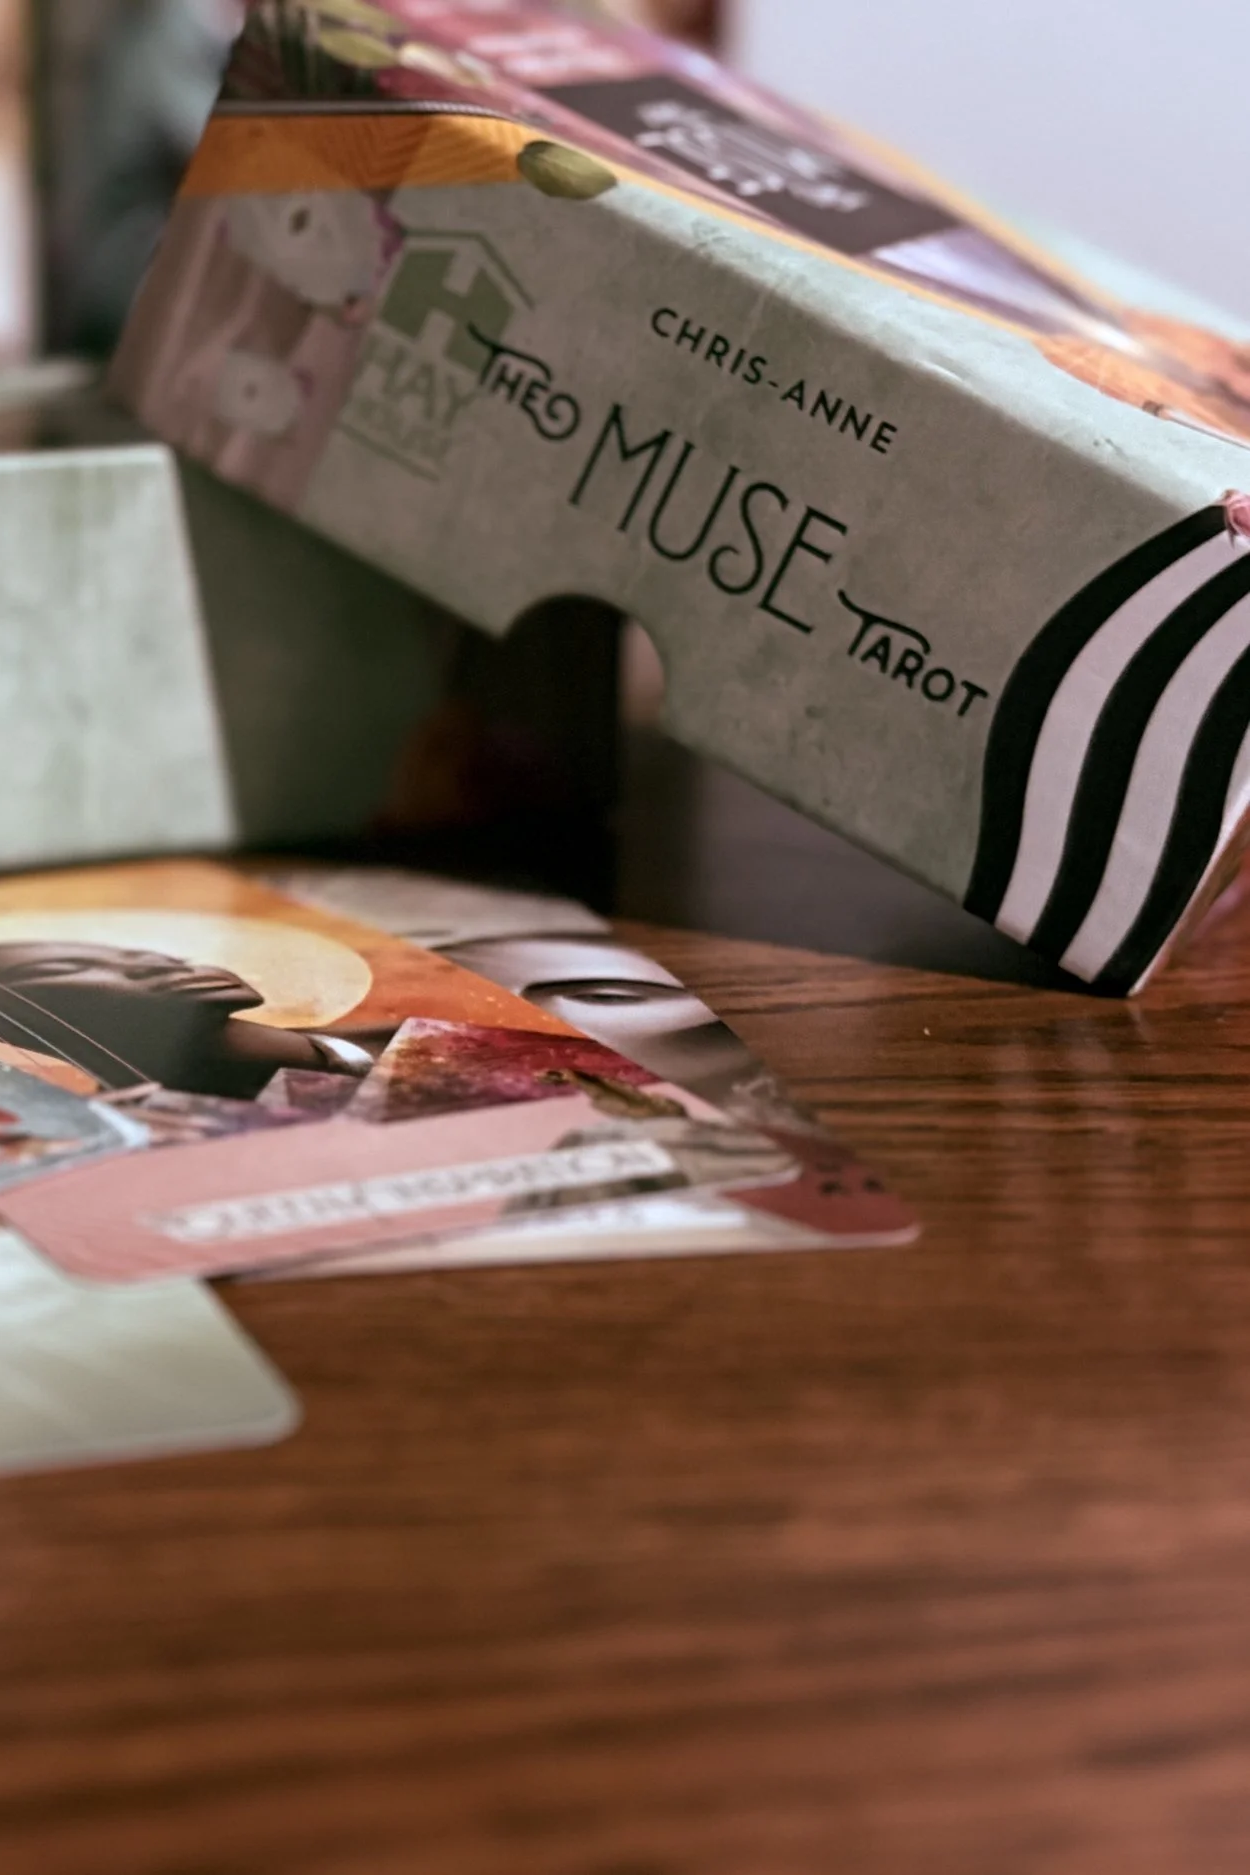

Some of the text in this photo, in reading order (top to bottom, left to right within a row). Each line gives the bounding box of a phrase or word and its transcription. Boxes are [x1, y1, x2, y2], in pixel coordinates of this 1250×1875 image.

[651, 307, 898, 454] CHRIS-ANNE
[568, 402, 848, 635] MUSE
[837, 589, 989, 718] TAROT
